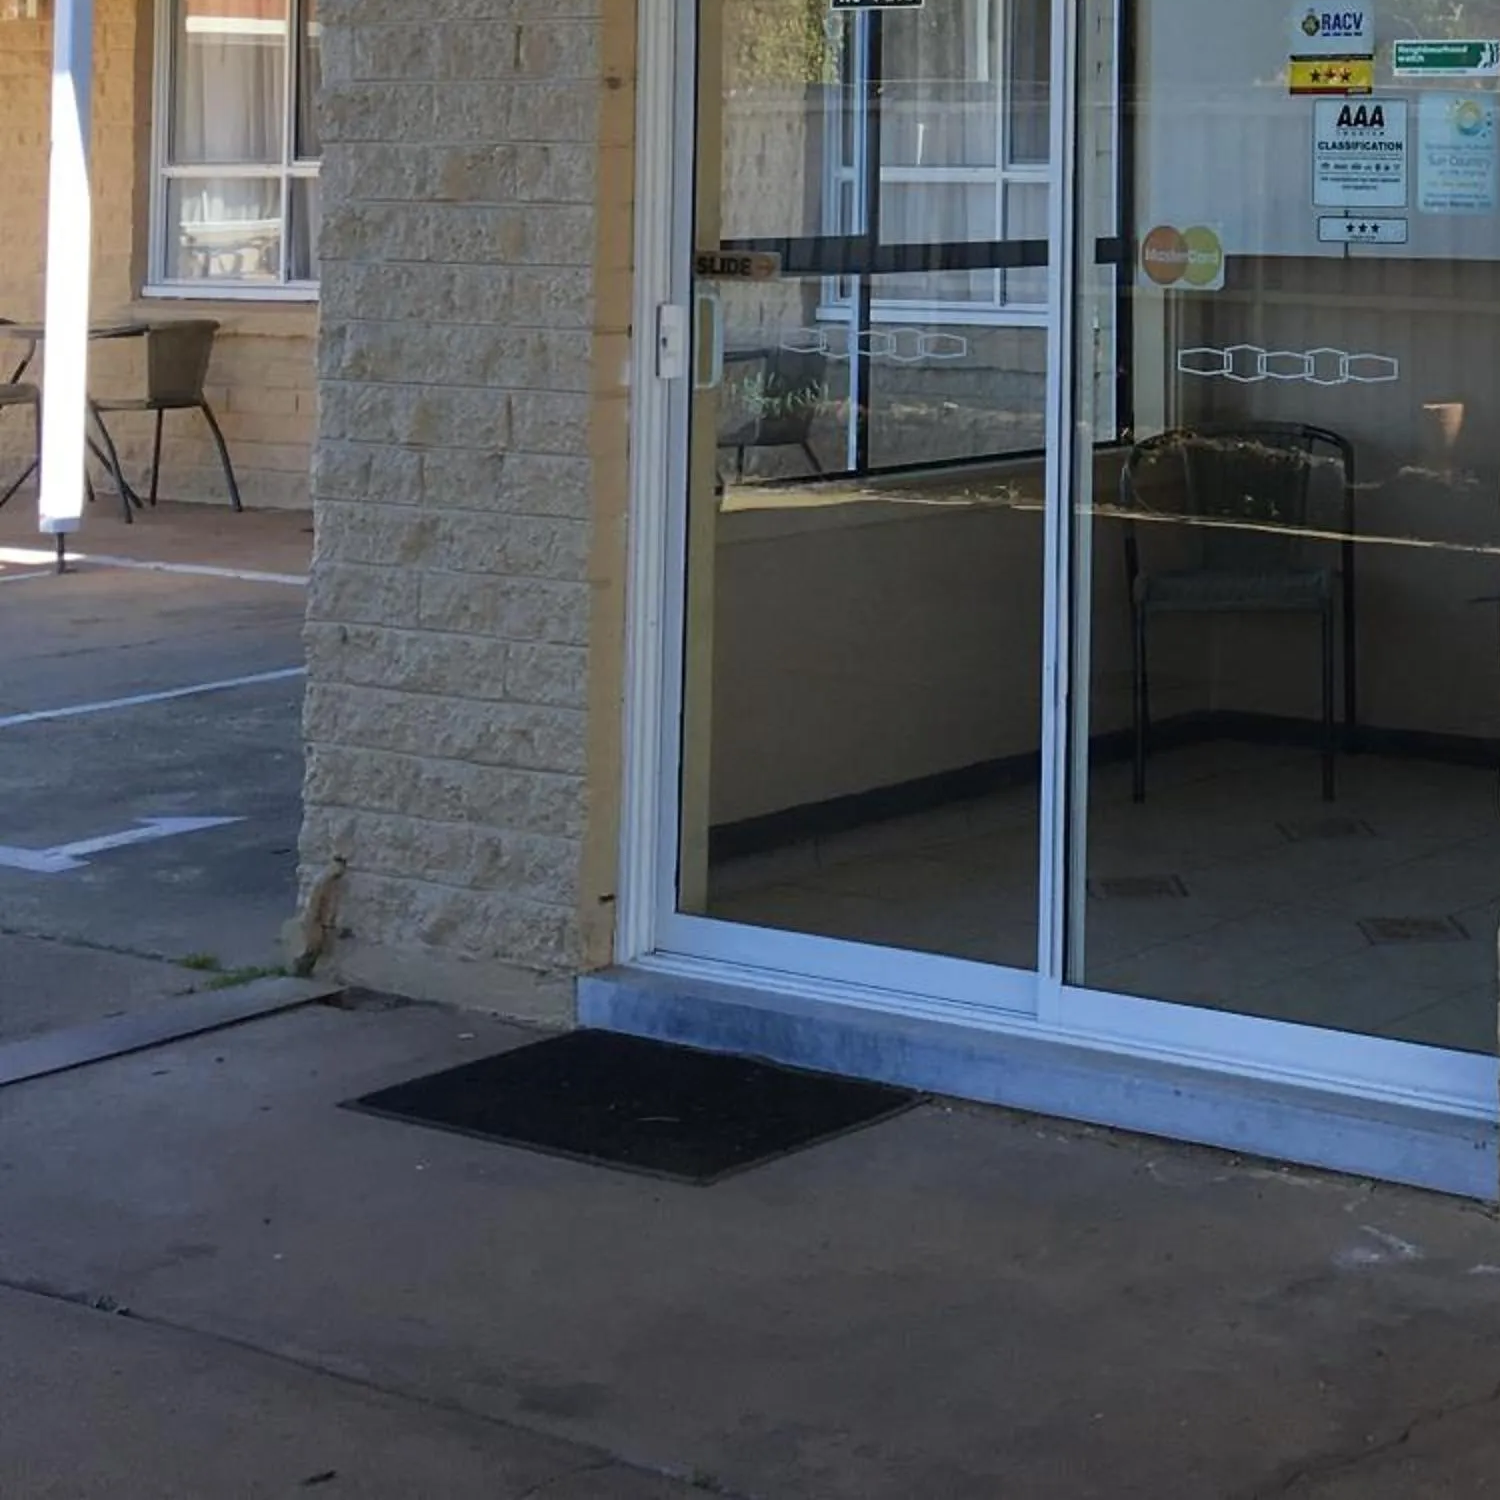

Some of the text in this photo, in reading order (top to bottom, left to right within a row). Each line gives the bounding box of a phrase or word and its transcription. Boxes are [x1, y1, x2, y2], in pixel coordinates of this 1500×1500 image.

[1321, 12, 1363, 31] RACV
[1336, 104, 1385, 127] AAA
[1317, 141, 1403, 152] CLASSIFICATION
[696, 256, 752, 277] SLIDE
